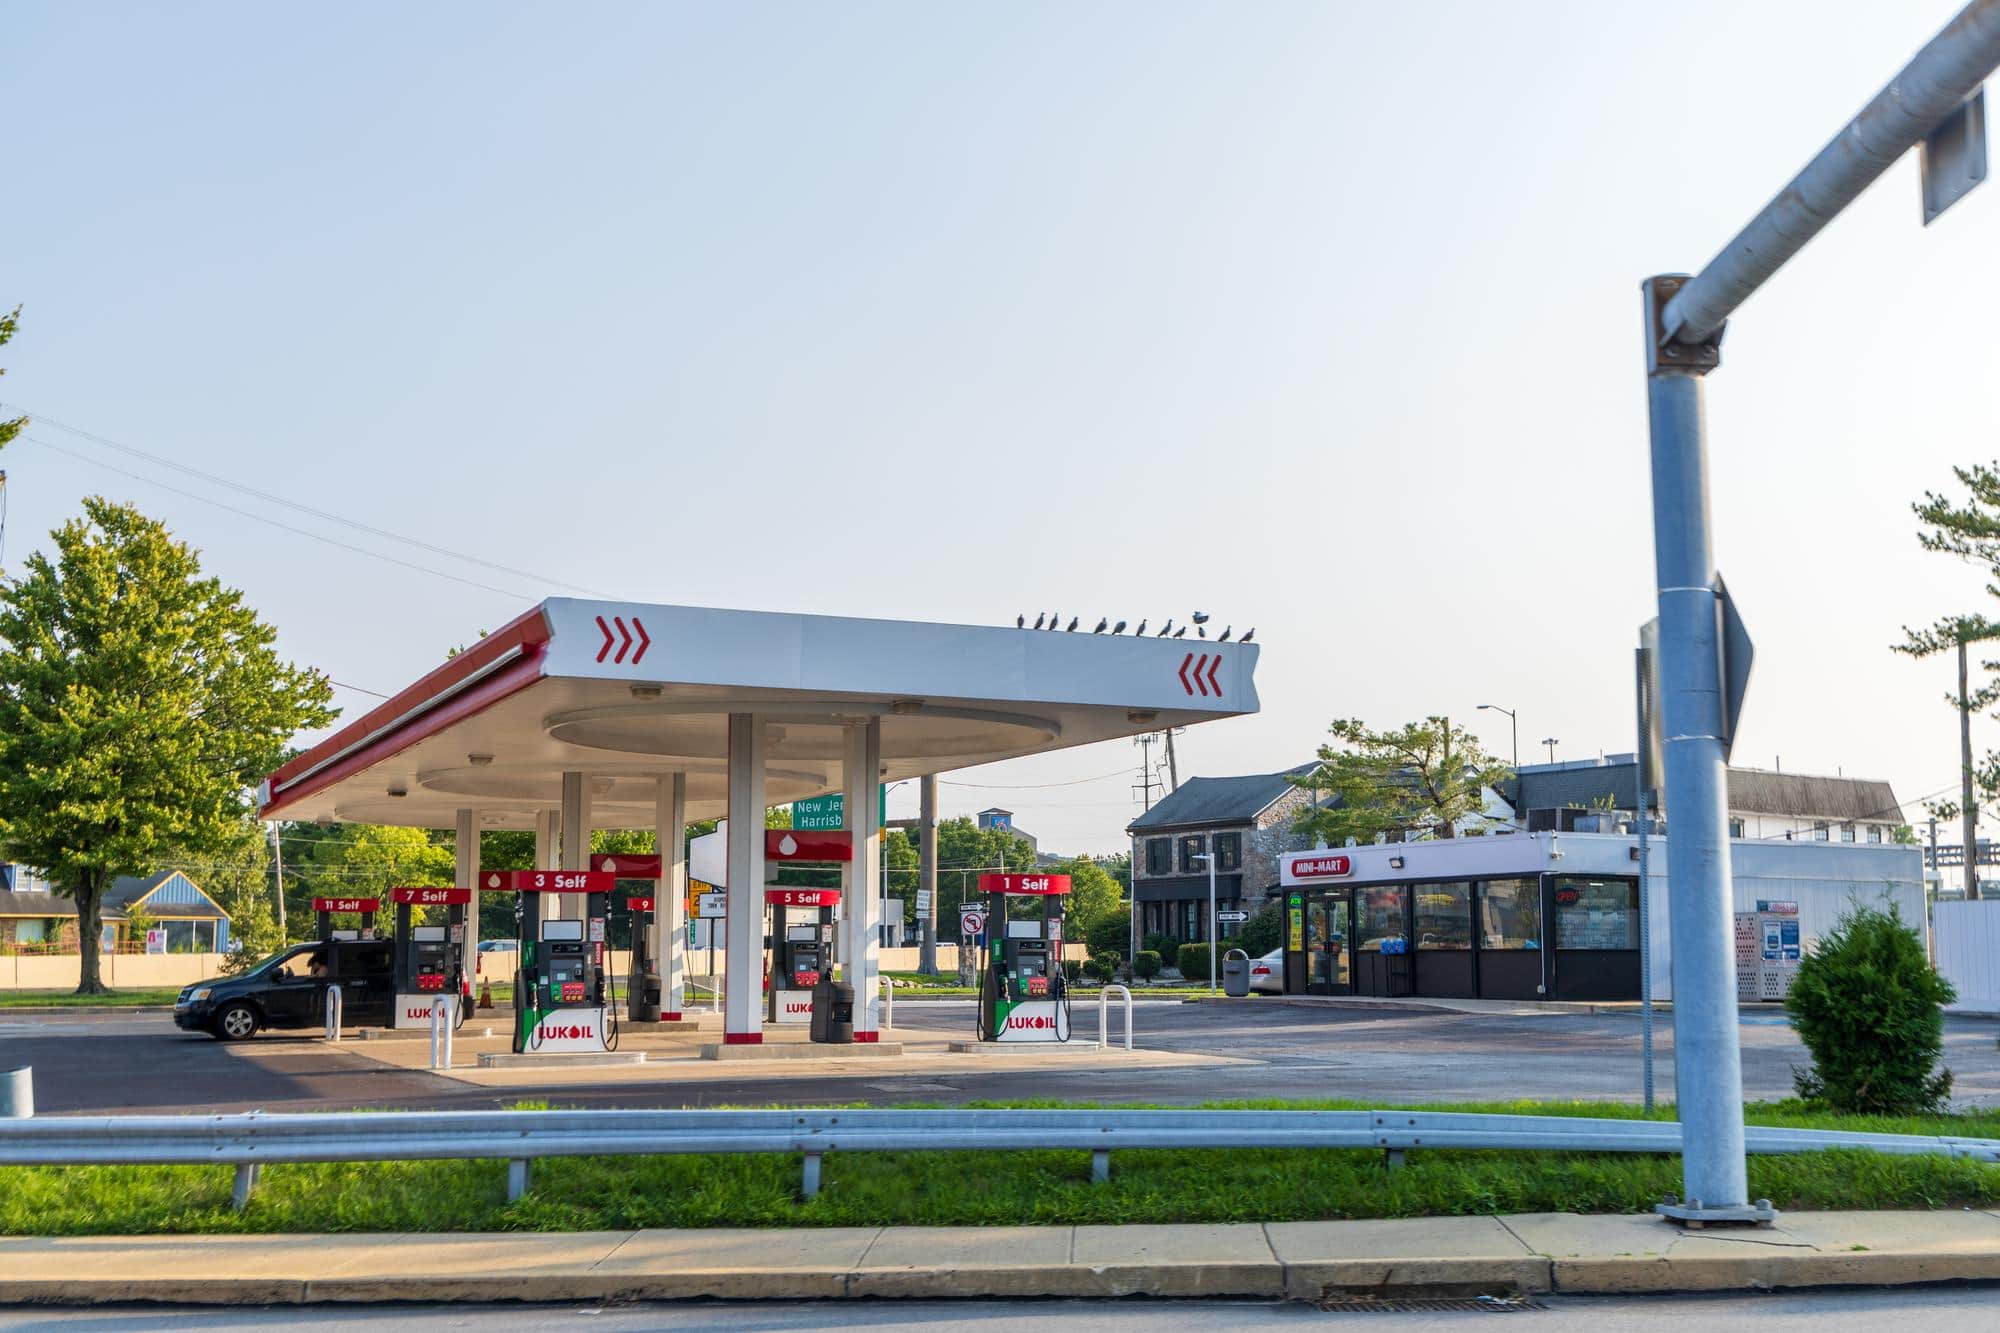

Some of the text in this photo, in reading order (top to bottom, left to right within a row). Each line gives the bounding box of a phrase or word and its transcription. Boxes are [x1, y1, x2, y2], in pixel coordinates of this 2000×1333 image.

[798, 800, 843, 813] New Jer
[801, 814, 842, 827] Harrisb
[1296, 860, 1341, 873] MINI-MART
[535, 874, 587, 888] 3 Self
[1004, 877, 1049, 890] 1 Self
[406, 890, 448, 902] 7 Self
[785, 893, 820, 903] 5 Self
[325, 901, 360, 910] 11 Self
[642, 900, 649, 909] 9
[1008, 1016, 1057, 1029] LUKOIL
[538, 1025, 594, 1039] LUKOIL
